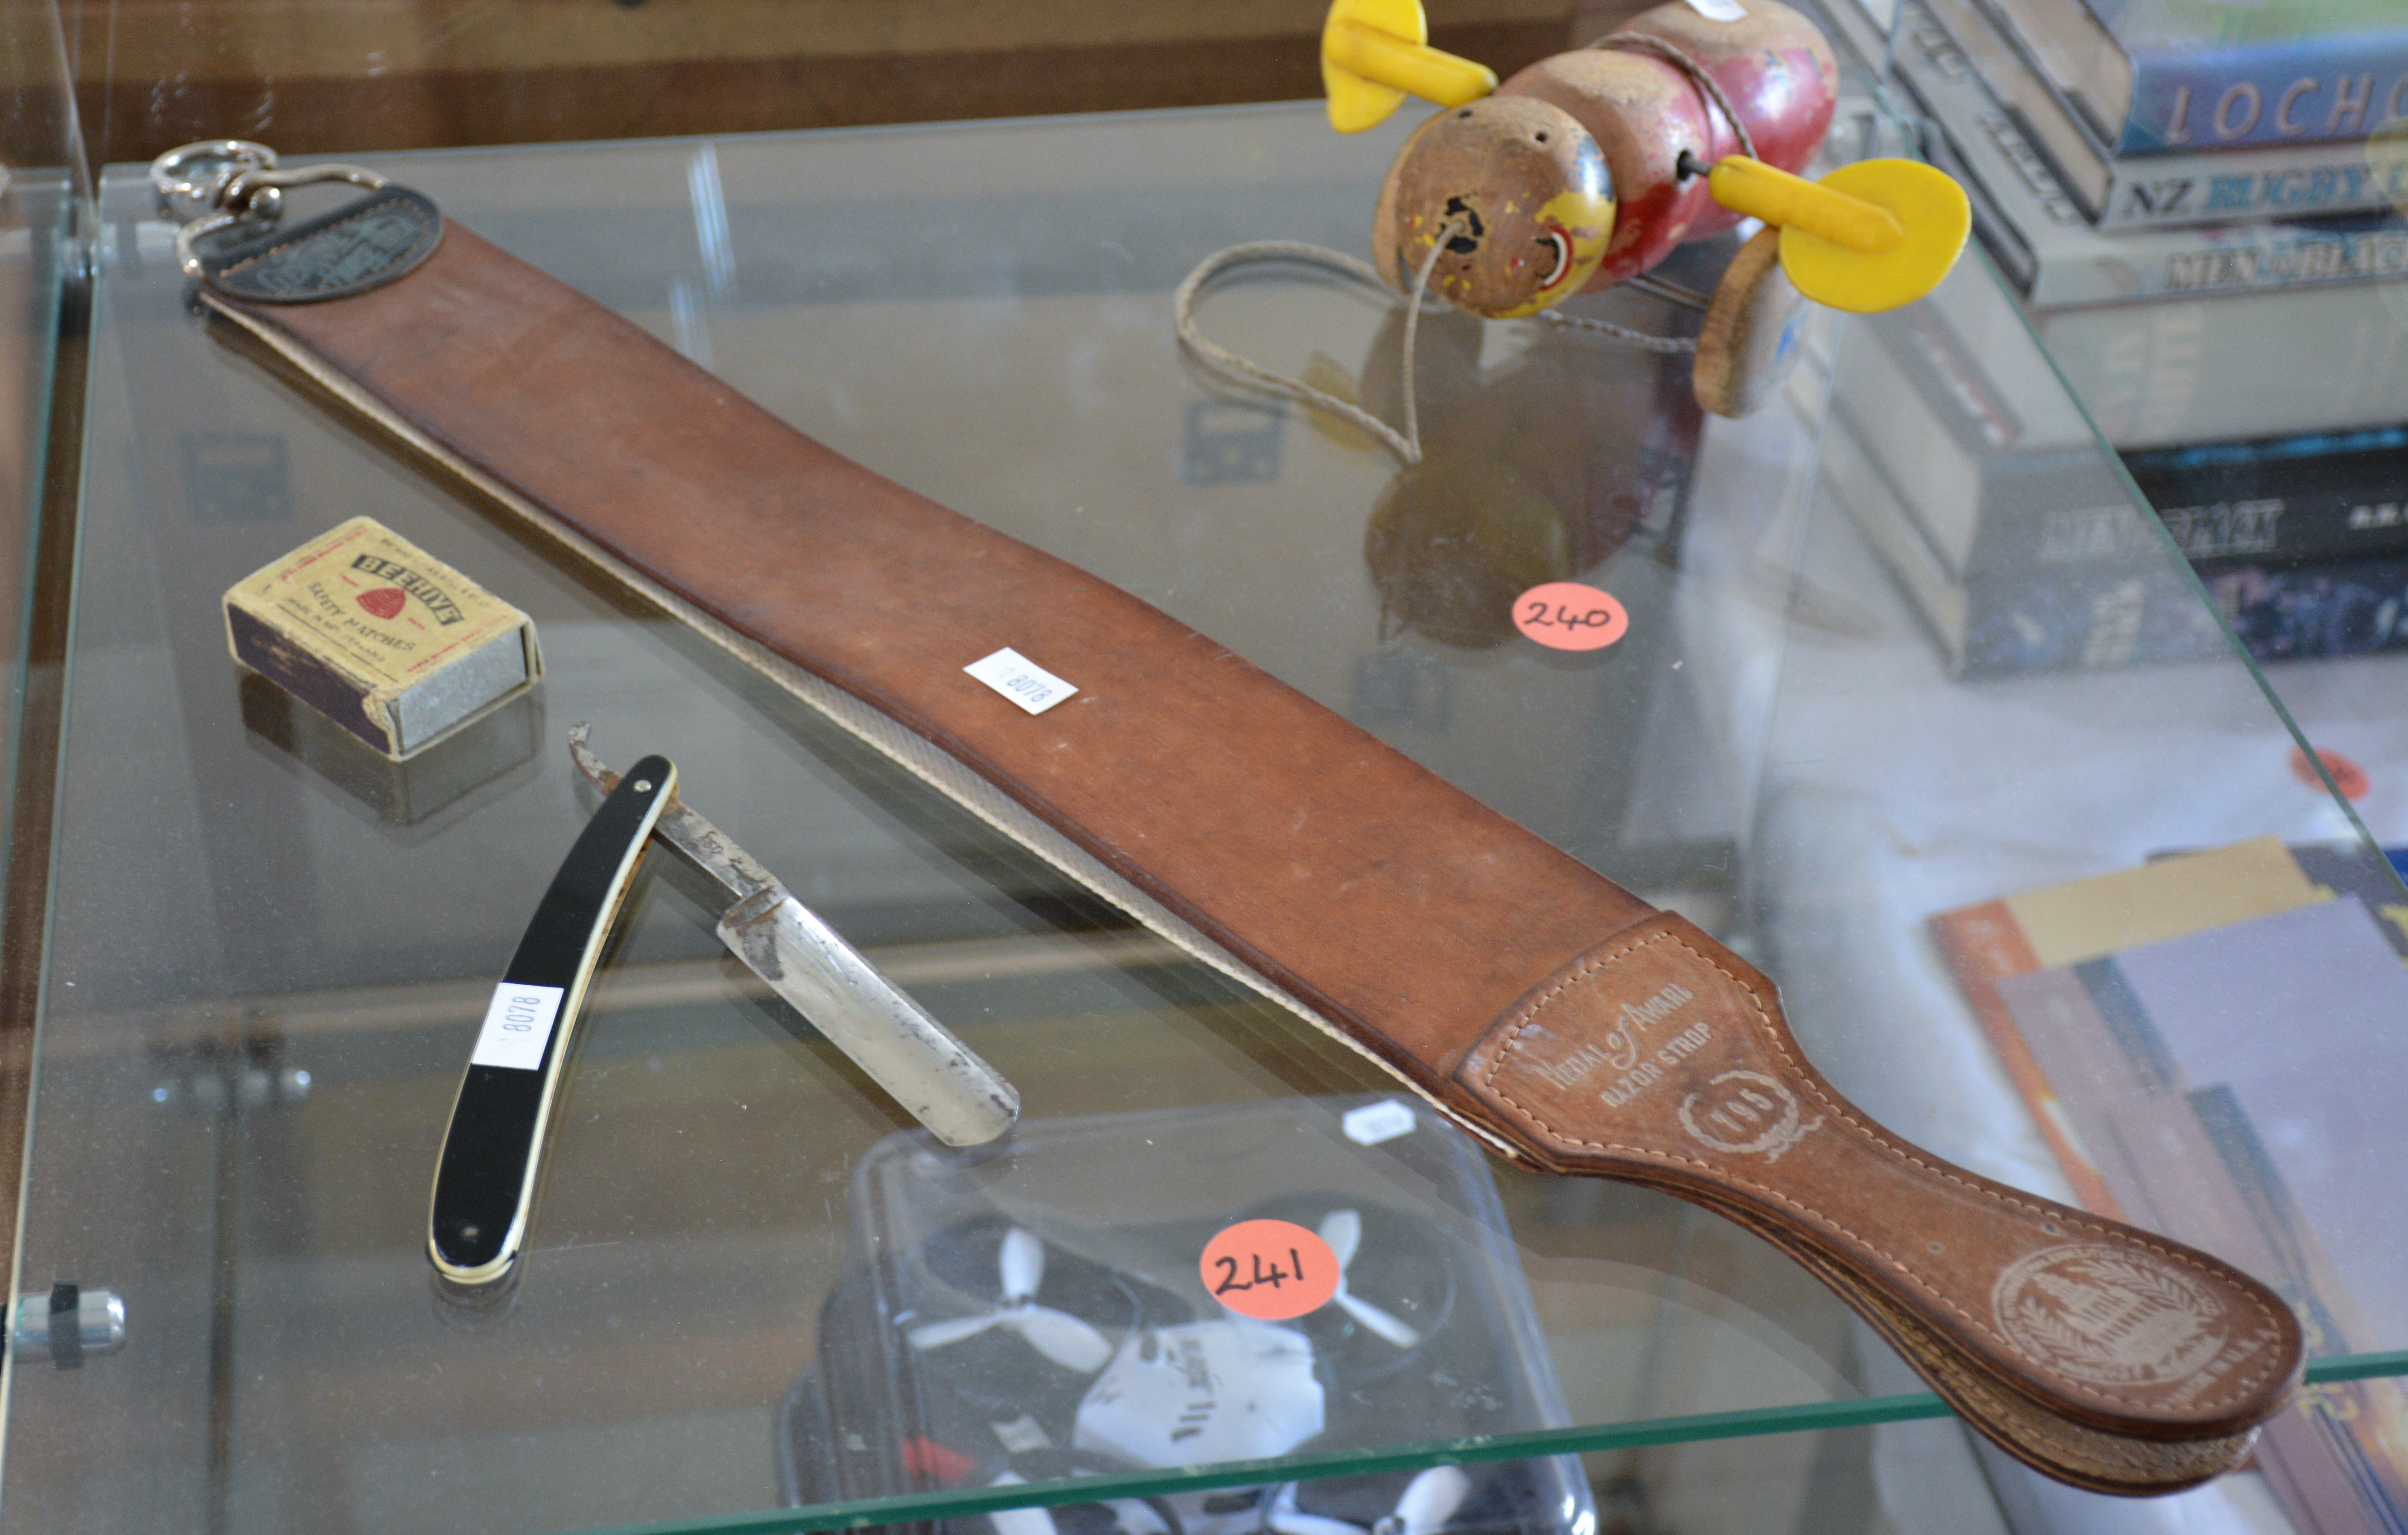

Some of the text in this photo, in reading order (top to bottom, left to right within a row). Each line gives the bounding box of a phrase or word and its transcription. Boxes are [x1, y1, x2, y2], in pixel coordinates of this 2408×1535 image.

[358, 556, 461, 623] BEEHIVE
[309, 582, 345, 617] SAFETY
[343, 618, 416, 651] MATCHES
[1523, 602, 1611, 632] 240
[1007, 674, 1053, 702] 8078
[501, 996, 541, 1032] 8078
[1600, 1022, 1711, 1107] RAZOR STROP
[1215, 1248, 1304, 1296] 241
